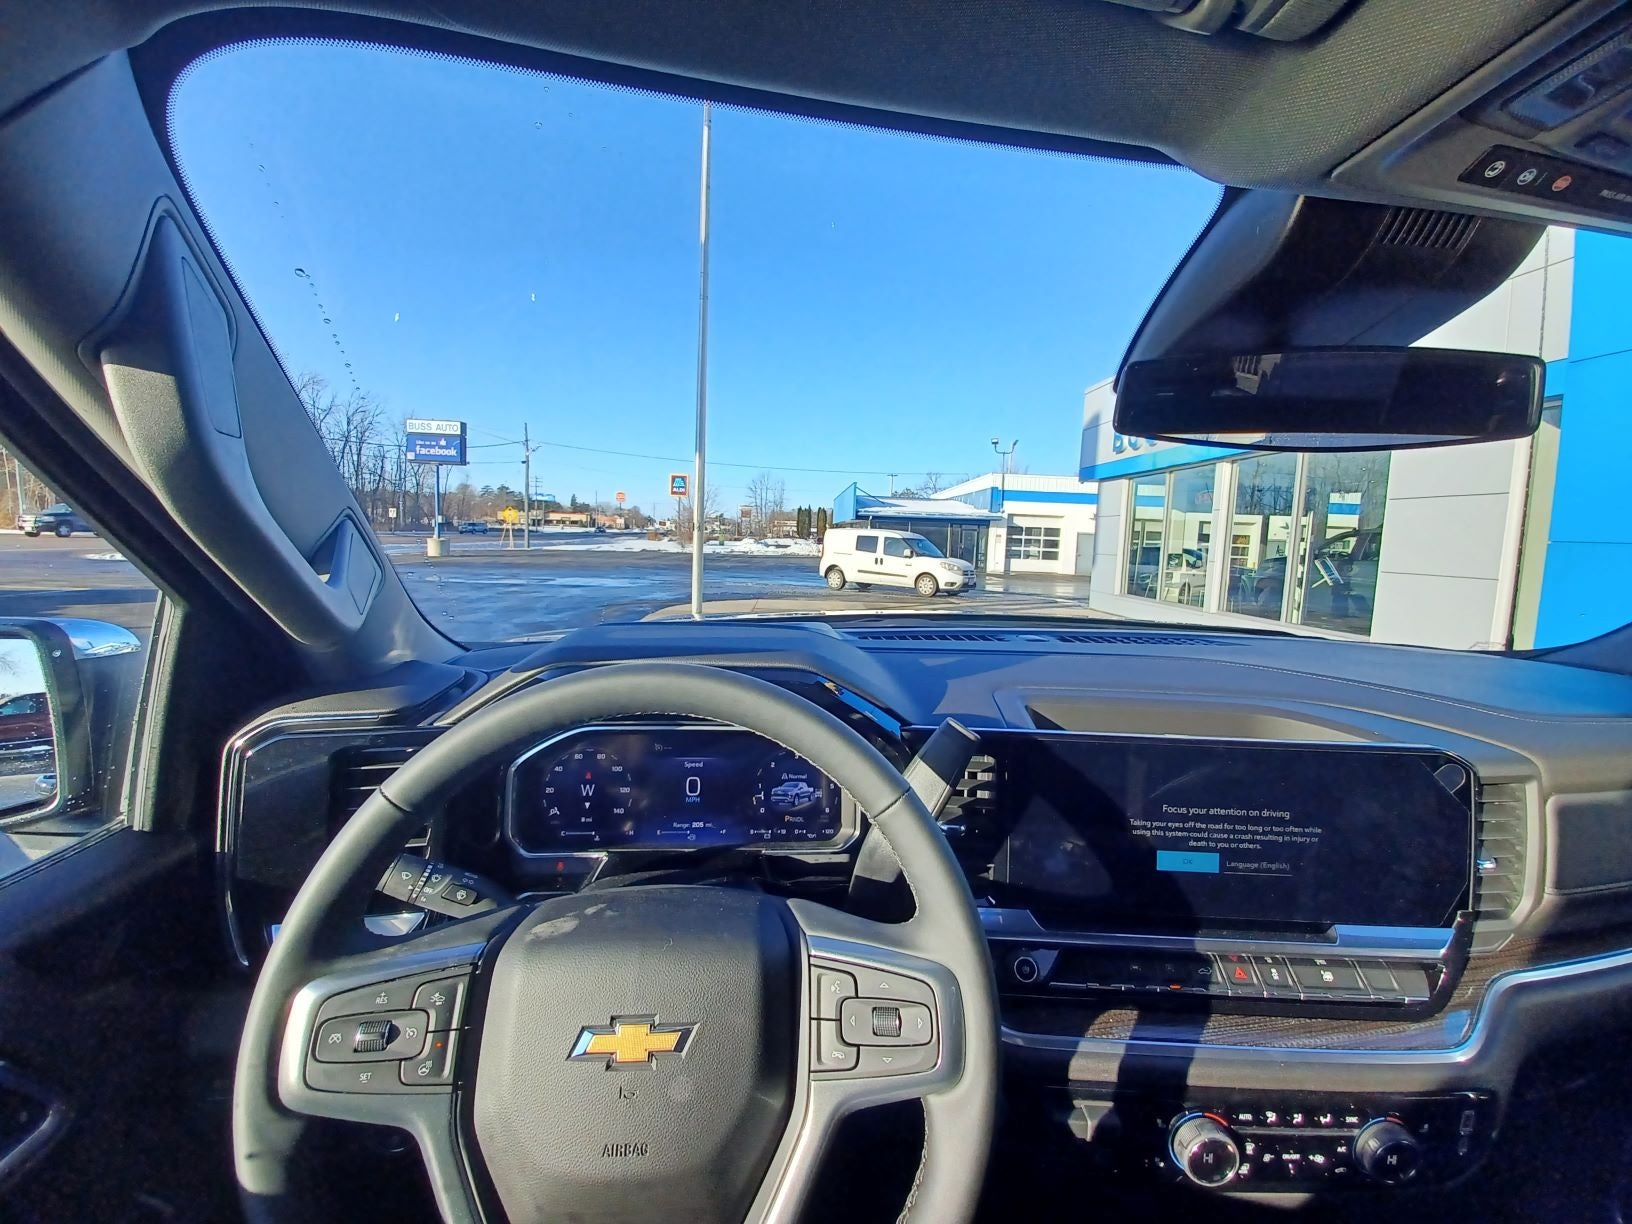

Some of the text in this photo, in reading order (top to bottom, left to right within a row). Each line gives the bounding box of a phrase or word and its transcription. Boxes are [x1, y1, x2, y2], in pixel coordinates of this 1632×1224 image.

[408, 422, 459, 432] BUSS AUTO
[415, 445, 457, 456] facebook
[580, 783, 595, 797] W
[685, 776, 701, 796] 0
[1162, 804, 1290, 821] Focus your attention on driving
[1129, 818, 1151, 828] Taking
[1151, 821, 1167, 829] your
[1167, 821, 1183, 830] eyes
[1184, 821, 1195, 829] off
[1195, 822, 1207, 830] the
[1207, 822, 1223, 830] road
[1223, 822, 1234, 830] for
[1235, 823, 1247, 831] too
[1247, 823, 1263, 833] long
[1285, 825, 1304, 833] often
[1304, 826, 1323, 834] while
[1132, 829, 1151, 837] using
[1165, 830, 1189, 838] system
[1189, 831, 1208, 839] could
[1253, 834, 1283, 843] resulting
[1291, 834, 1310, 843] injury
[1238, 841, 1262, 849] others.
[1226, 860, 1290, 871] Language (English)
[423, 886, 434, 894] OFF
[360, 1072, 372, 1080] SET
[1239, 1113, 1253, 1121] AUTO
[1345, 1116, 1359, 1124] SYNC
[601, 1142, 649, 1158] AIRBAG
[1203, 1152, 1214, 1164] HI
[1386, 1154, 1398, 1165] HI
